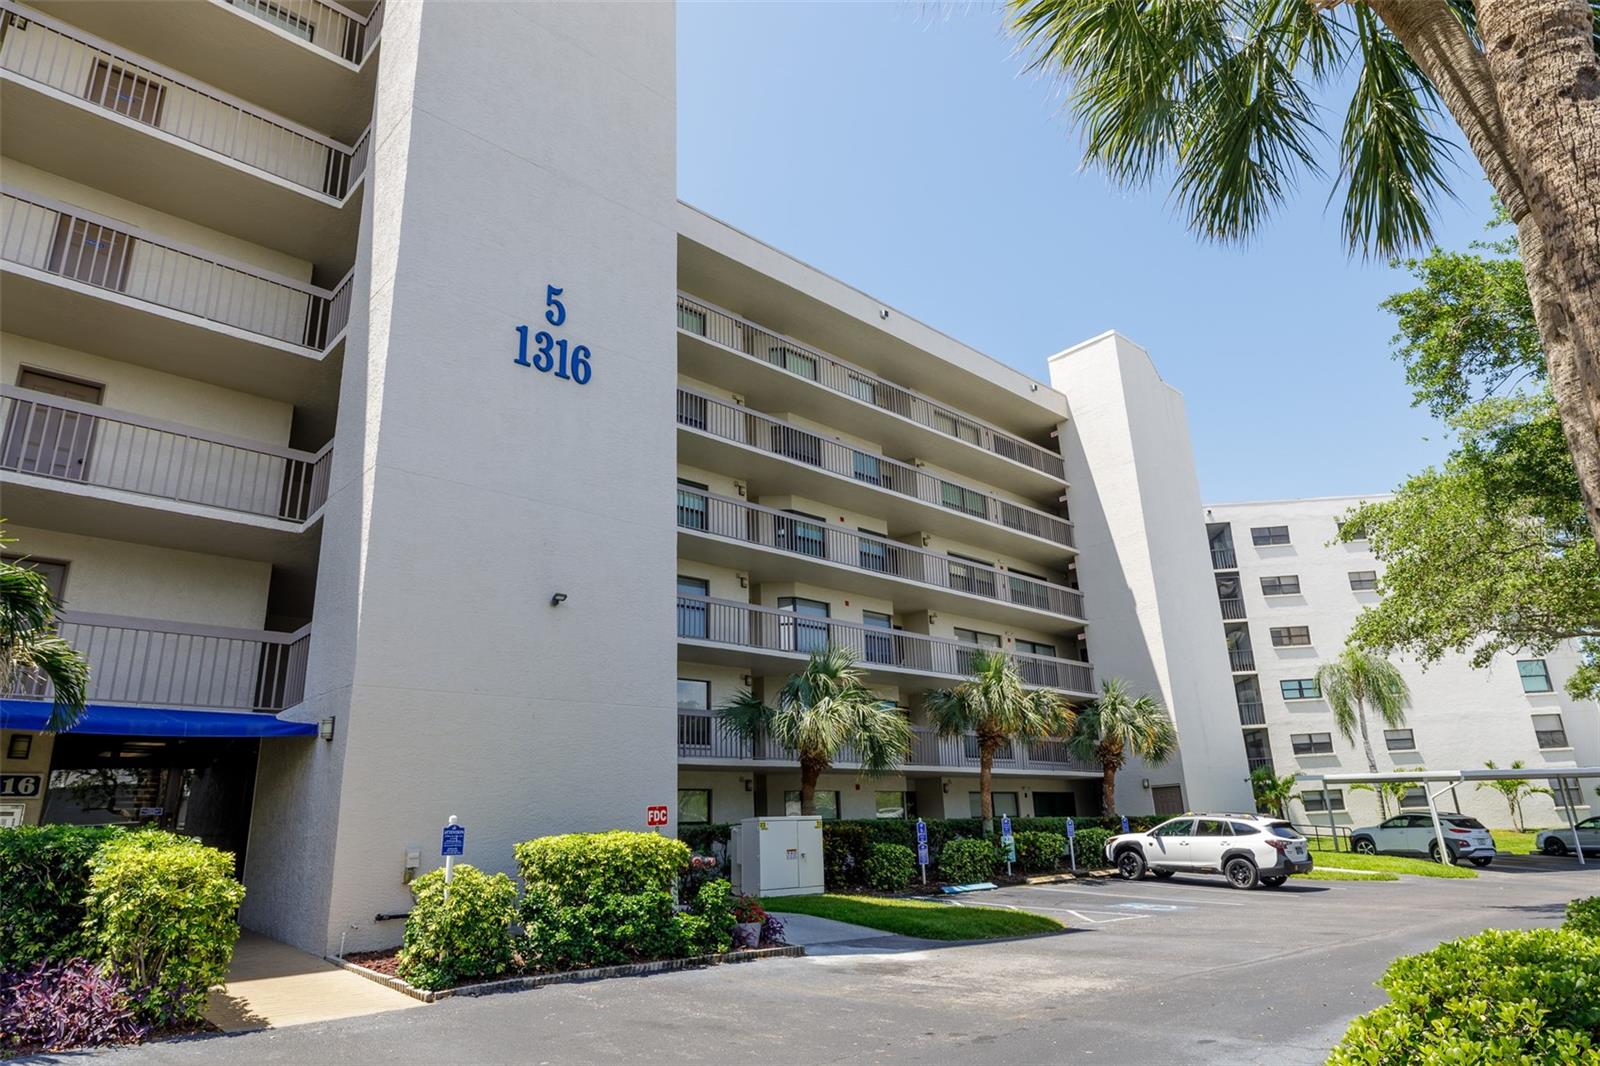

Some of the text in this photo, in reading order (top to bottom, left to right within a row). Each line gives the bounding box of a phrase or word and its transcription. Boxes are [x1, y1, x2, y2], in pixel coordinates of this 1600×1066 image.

[545, 284, 566, 327] 5
[514, 325, 592, 385] 1316
[1, 777, 35, 794] 16
[648, 810, 667, 822] FDC
